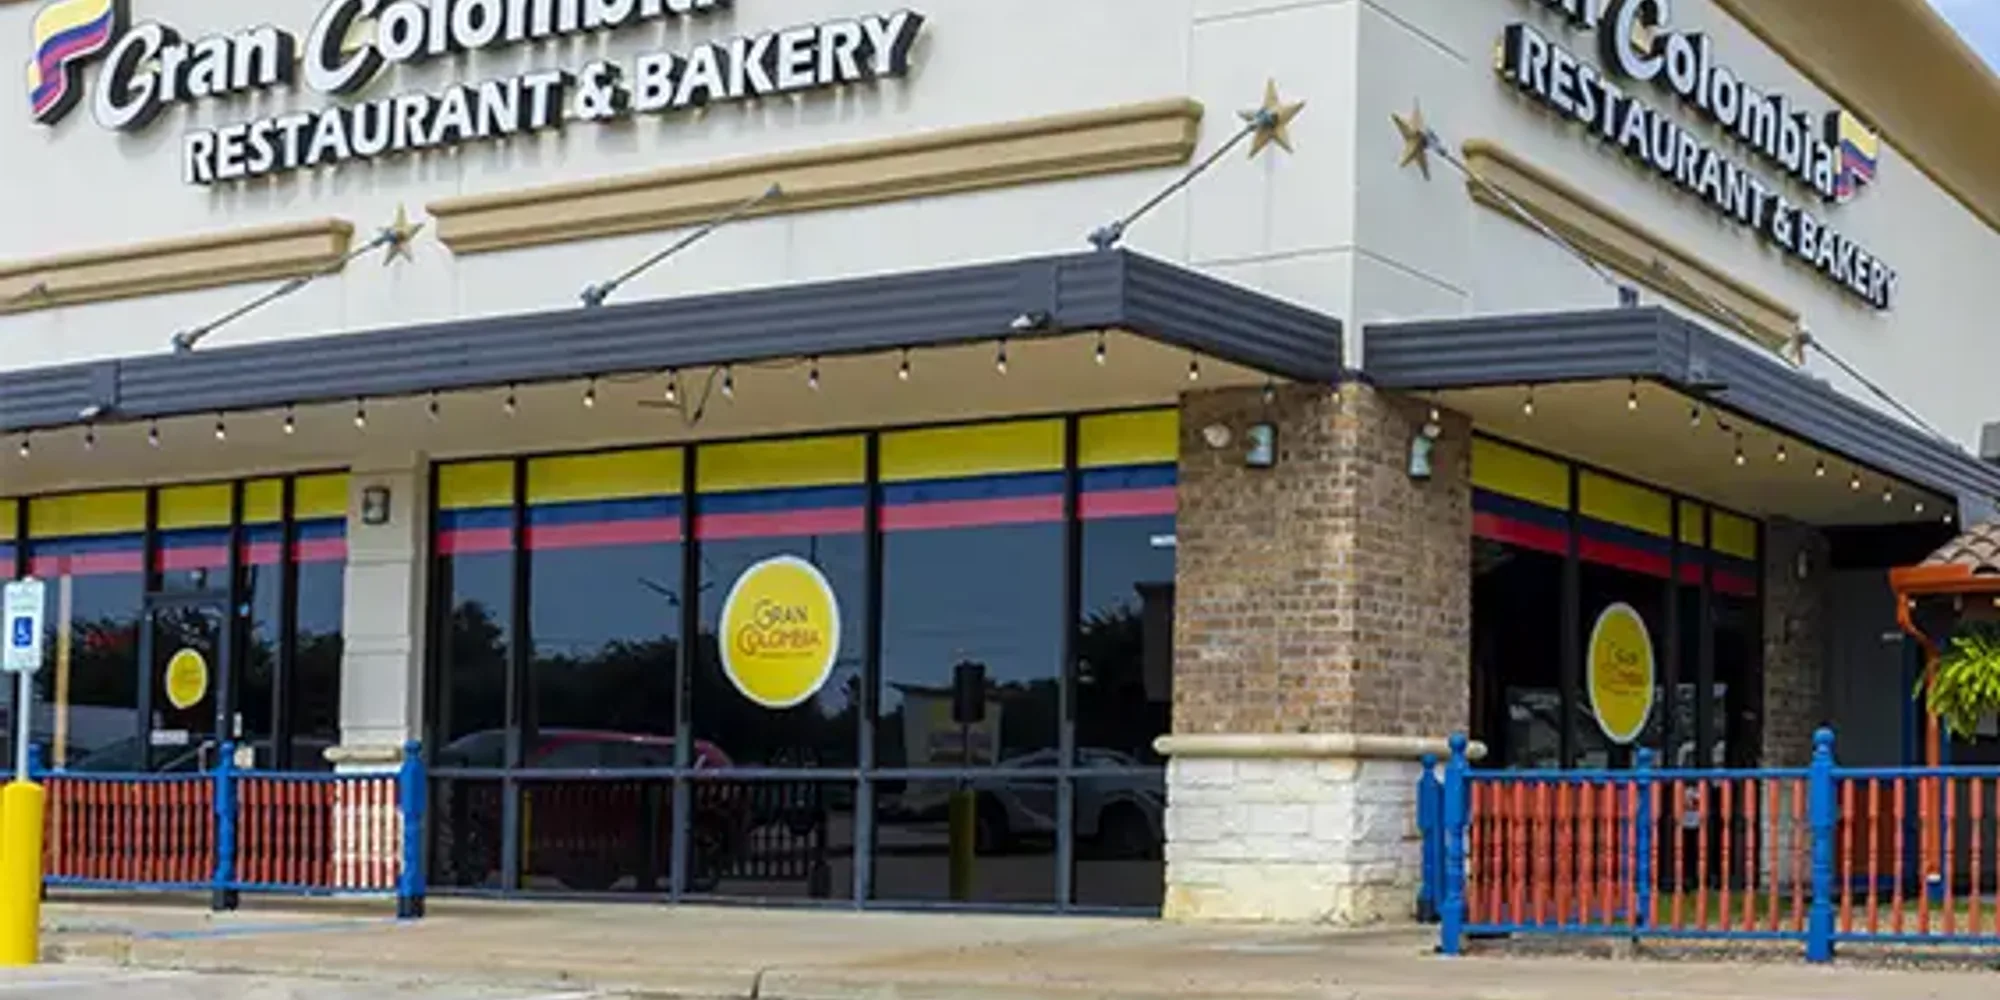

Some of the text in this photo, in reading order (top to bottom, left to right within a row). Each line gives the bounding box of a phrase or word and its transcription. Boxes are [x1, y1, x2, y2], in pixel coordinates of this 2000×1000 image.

[96, 0, 722, 130] Gran Colom
[184, 12, 916, 184] RESTAURANT & BAKERY
[1611, 0, 1836, 196] Colombia
[1517, 24, 1900, 306] RESTAURANT & BAKERY
